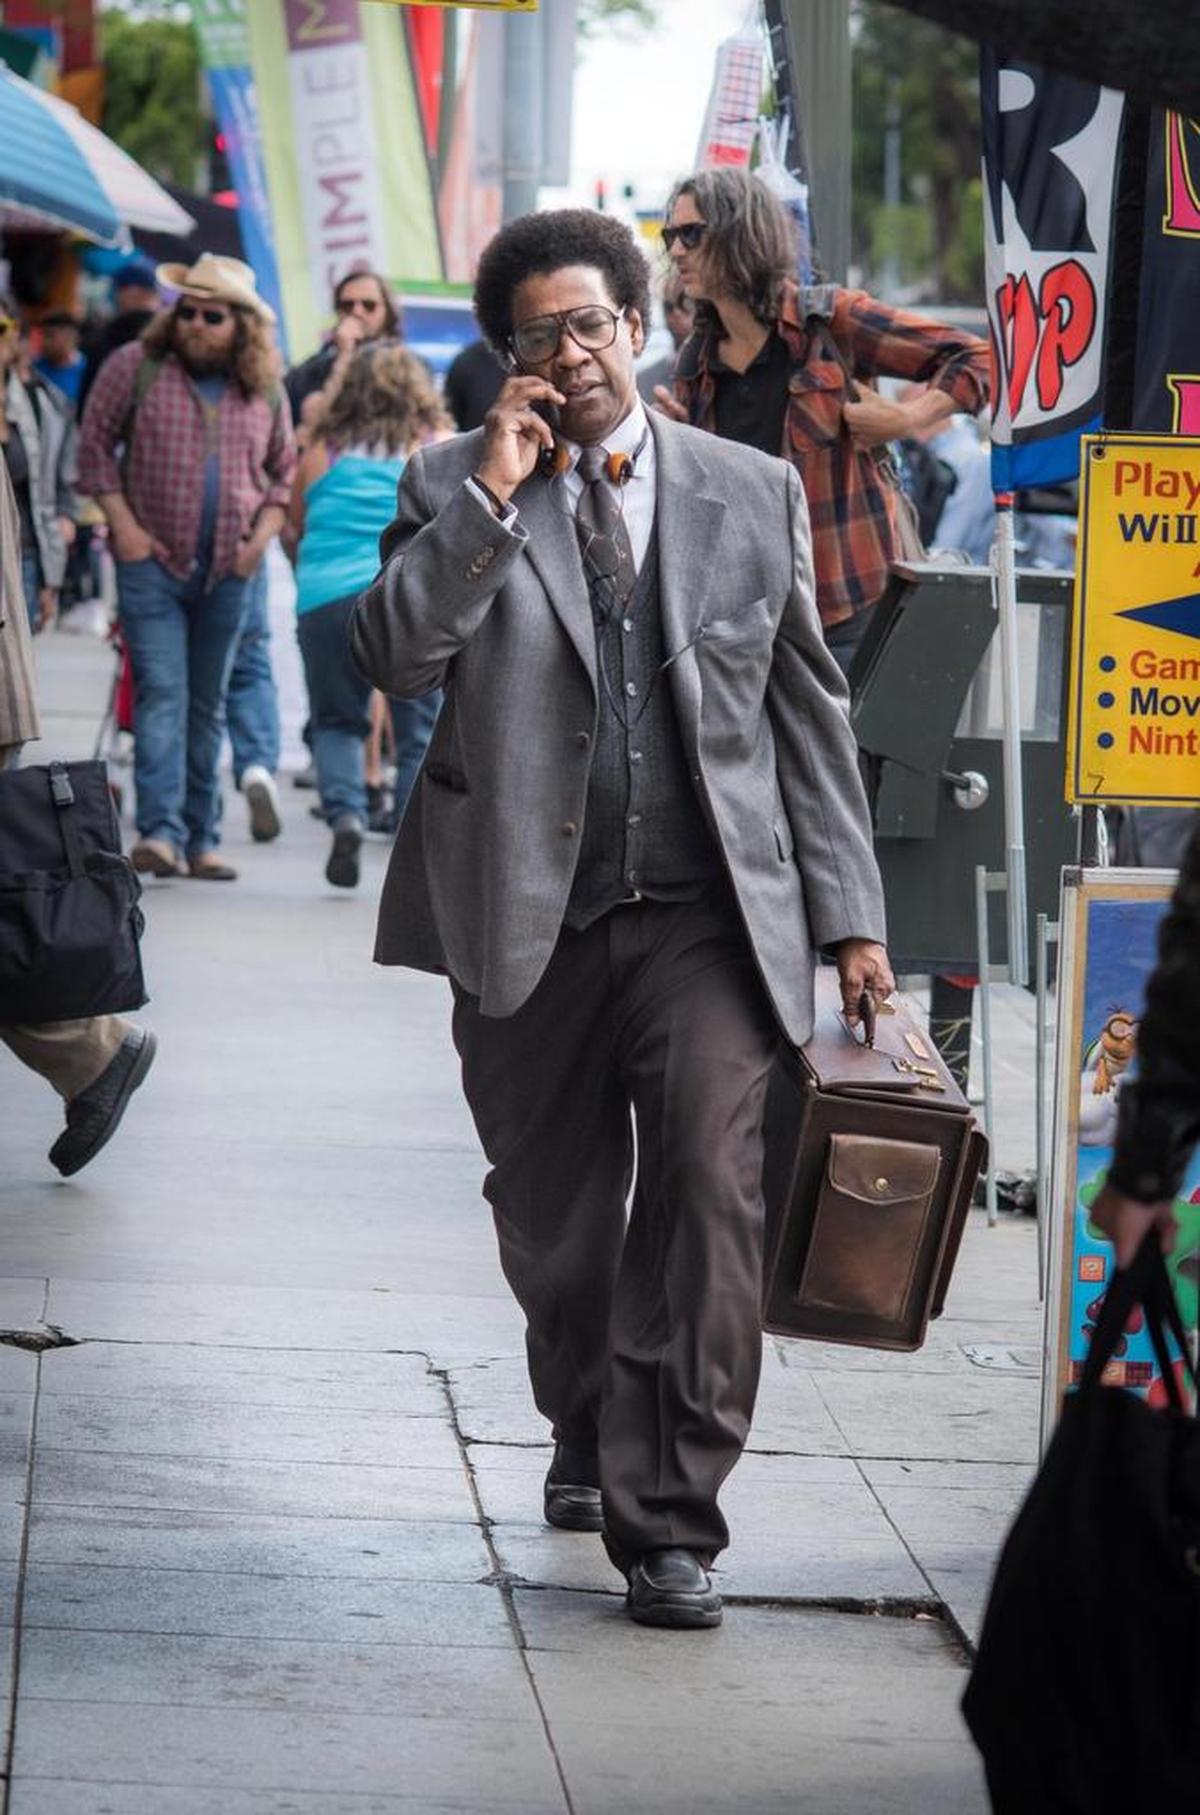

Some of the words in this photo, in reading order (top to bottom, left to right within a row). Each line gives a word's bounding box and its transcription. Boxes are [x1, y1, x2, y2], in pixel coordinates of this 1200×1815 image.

[1114, 460, 1200, 511] Play
[1130, 686, 1200, 717] Mov
[1129, 725, 1200, 757] Nint
